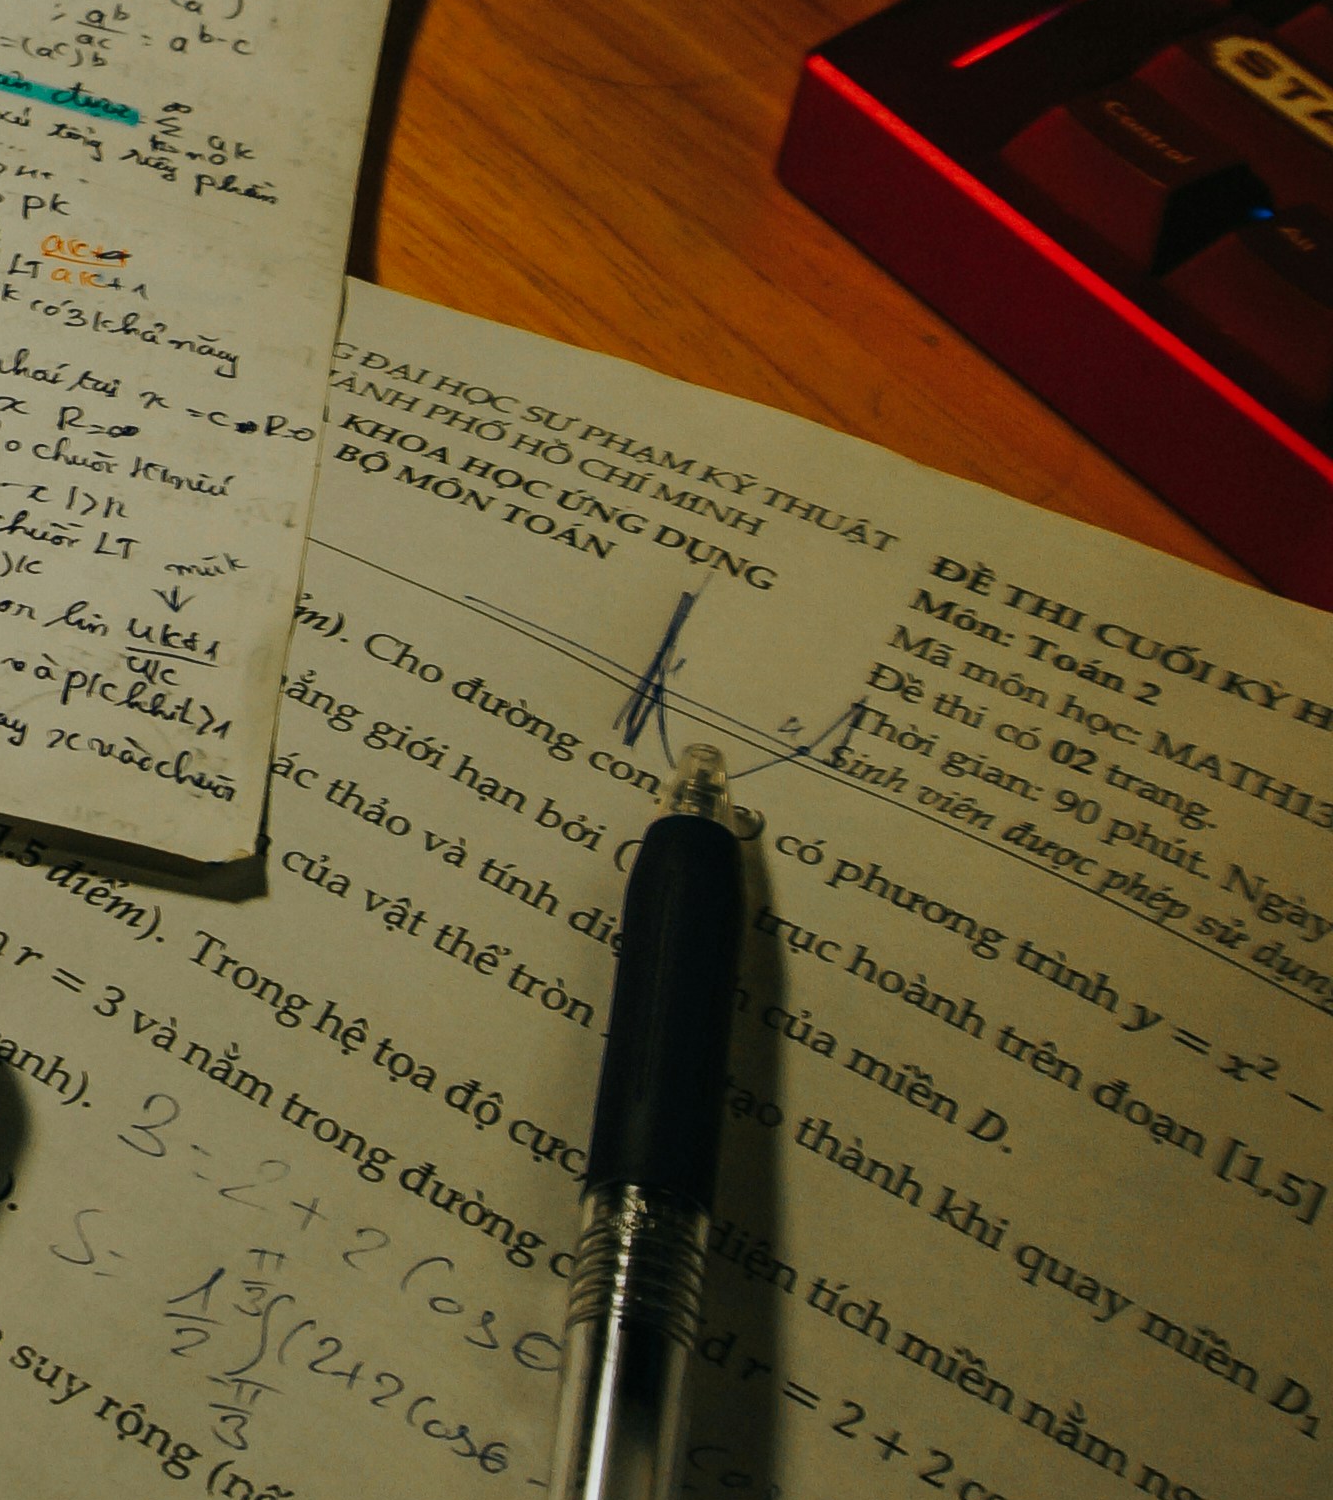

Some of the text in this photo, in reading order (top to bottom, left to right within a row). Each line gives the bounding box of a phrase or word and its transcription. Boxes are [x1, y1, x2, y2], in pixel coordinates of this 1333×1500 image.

[1103, 99, 1198, 167] Control
[330, 369, 769, 540] ÀNH PHỐ HỒ CHÍ MINH
[333, 441, 620, 561] BỘ MÔN TOÁN
[338, 412, 779, 592] KHOA HỌC ỨNG DỤNG
[358, 350, 427, 386] ĐẠI
[430, 373, 520, 415] HỌC
[520, 403, 579, 435] SƯ
[578, 424, 698, 479] PHẠM
[697, 461, 759, 496] KỸ
[756, 482, 901, 556] THUẬT
[887, 623, 959, 668] Mã
[960, 661, 1049, 710] môn
[1055, 695, 1143, 748] học:
[908, 588, 1165, 706] Môn: Toán 2
[929, 554, 1293, 713] ĐỀ THI CUỐI KỲ
[363, 632, 1122, 1013] Cho đường có phương trình
[850, 701, 1333, 945] Thời gian: 90 phút. Ngày
[865, 662, 1220, 832] Đề thi có 02 trang.
[363, 720, 452, 771] giới
[450, 755, 529, 814] hạn
[534, 798, 608, 853] bởi
[752, 904, 844, 965] trục
[844, 944, 991, 1041] hoành
[993, 1024, 1086, 1092] trên
[1092, 1078, 1209, 1159] đoạn
[827, 744, 1252, 952] Sinh viên được phép sử
[324, 778, 966, 1126] thảo và tính của miền
[46, 859, 167, 944] điểm).
[188, 928, 315, 1029] Trong
[310, 1002, 373, 1058] hệ
[369, 1036, 438, 1094] tọa
[443, 1075, 506, 1129] độ
[805, 1275, 893, 1347] tích
[891, 1328, 1019, 1416] miền
[1020, 1400, 1133, 1479] nằm
[132, 1006, 180, 1052] và
[179, 1040, 274, 1109] nằm
[279, 1090, 400, 1185] trong
[397, 1160, 547, 1268] đường
[281, 849, 1267, 1395] của vật thể tròn thành khi quay miền
[7, 1340, 95, 1407] suy
[93, 1393, 204, 1483] rộng
